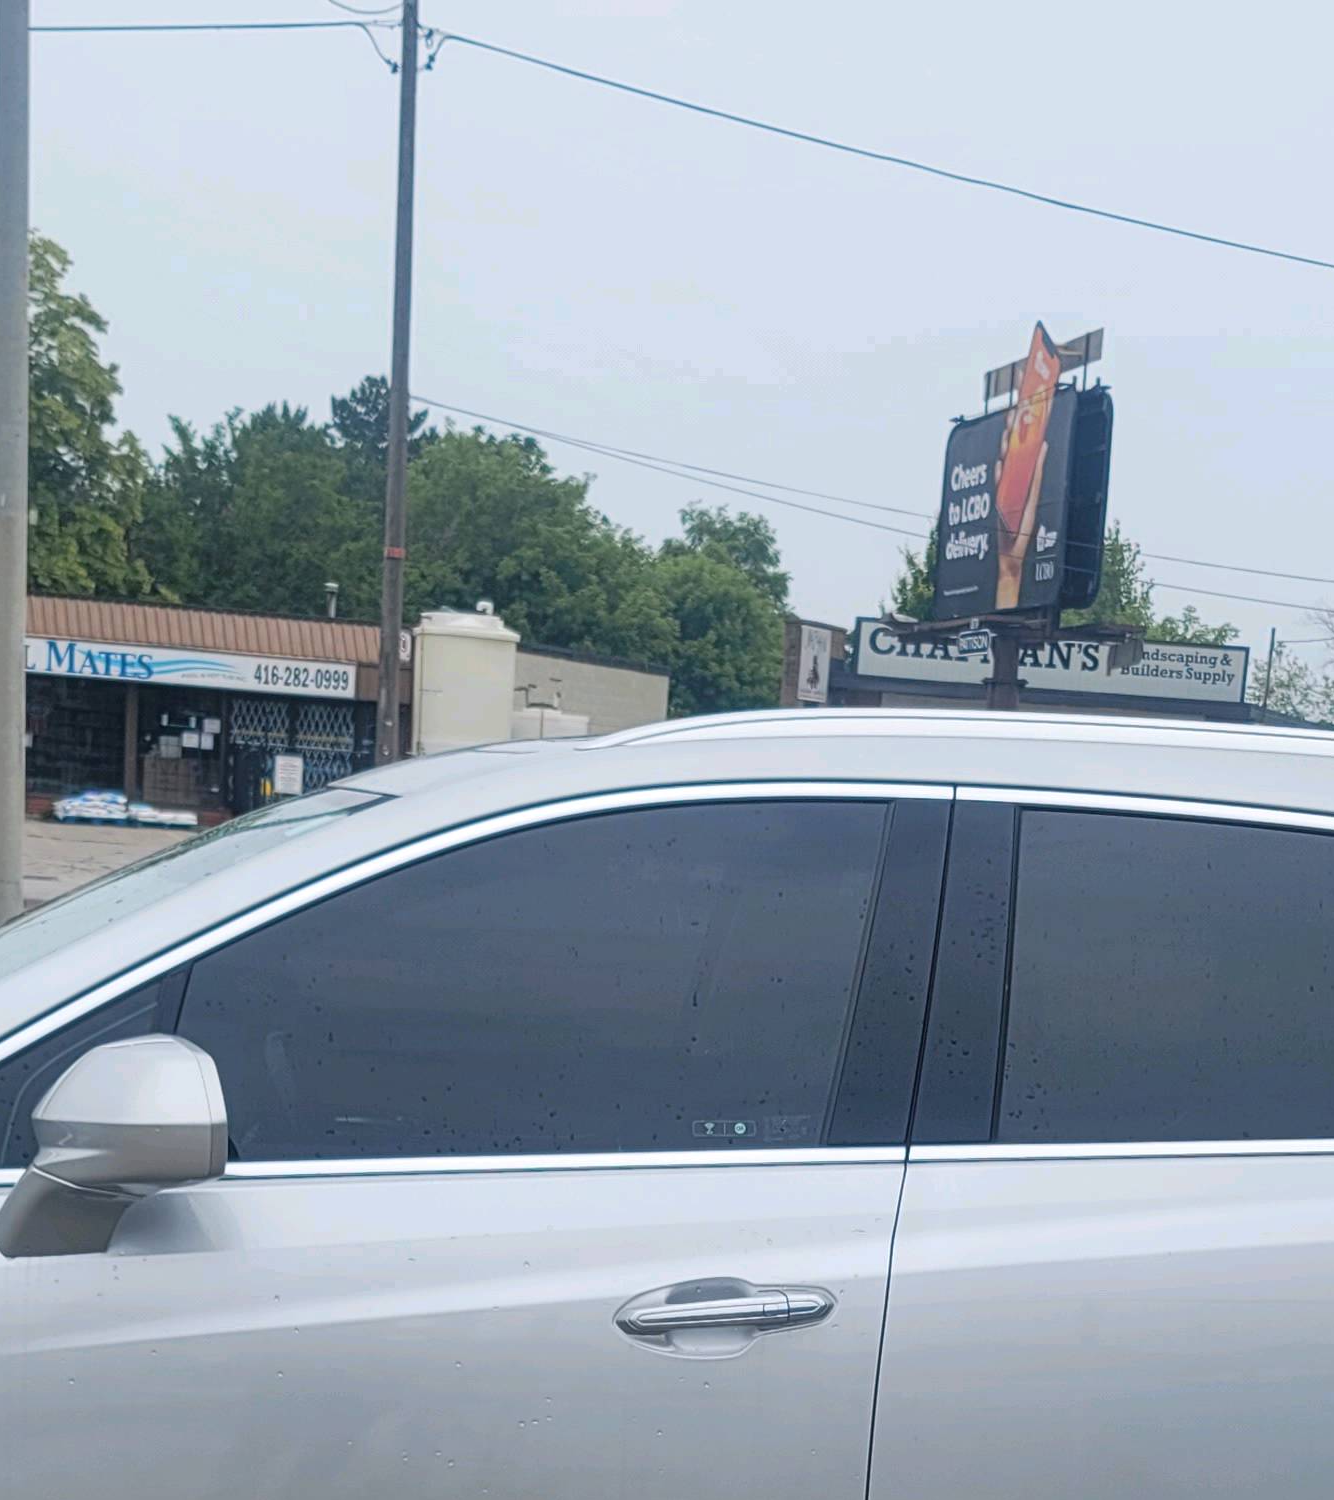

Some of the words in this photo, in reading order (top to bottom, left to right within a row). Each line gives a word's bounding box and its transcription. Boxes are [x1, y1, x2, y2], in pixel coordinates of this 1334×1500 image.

[951, 464, 987, 491] Cheers
[948, 502, 961, 526] to
[962, 493, 990, 523] LCBO
[946, 531, 989, 560] delivery.
[45, 640, 154, 680] MATES
[1220, 653, 1233, 666] &
[253, 663, 350, 691] 416-282-0999
[1121, 663, 1183, 679] Builders
[1185, 668, 1235, 686] Supply
